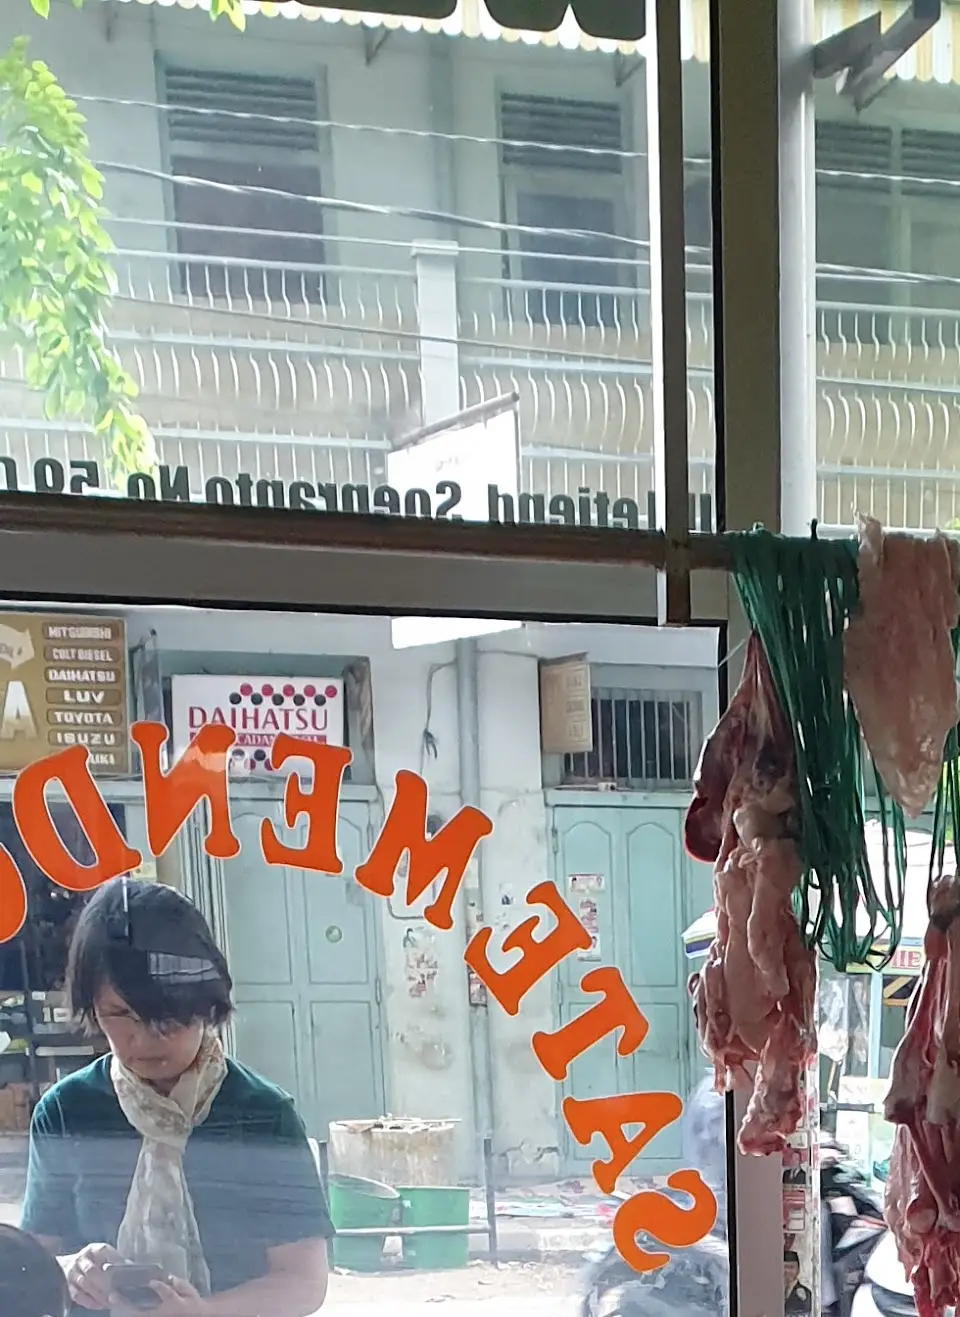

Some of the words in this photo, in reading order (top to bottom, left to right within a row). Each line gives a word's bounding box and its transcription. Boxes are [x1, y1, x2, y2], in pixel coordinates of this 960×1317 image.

[48, 626, 112, 639] MITSUBISHI
[52, 648, 76, 660] COLT
[78, 649, 113, 661] DIESEL
[48, 669, 115, 682] DAIHATSU
[63, 690, 105, 704] LUV
[54, 711, 114, 725] TOYOTA
[188, 706, 328, 731] DAIHATSU
[56, 732, 116, 746] ISUZU
